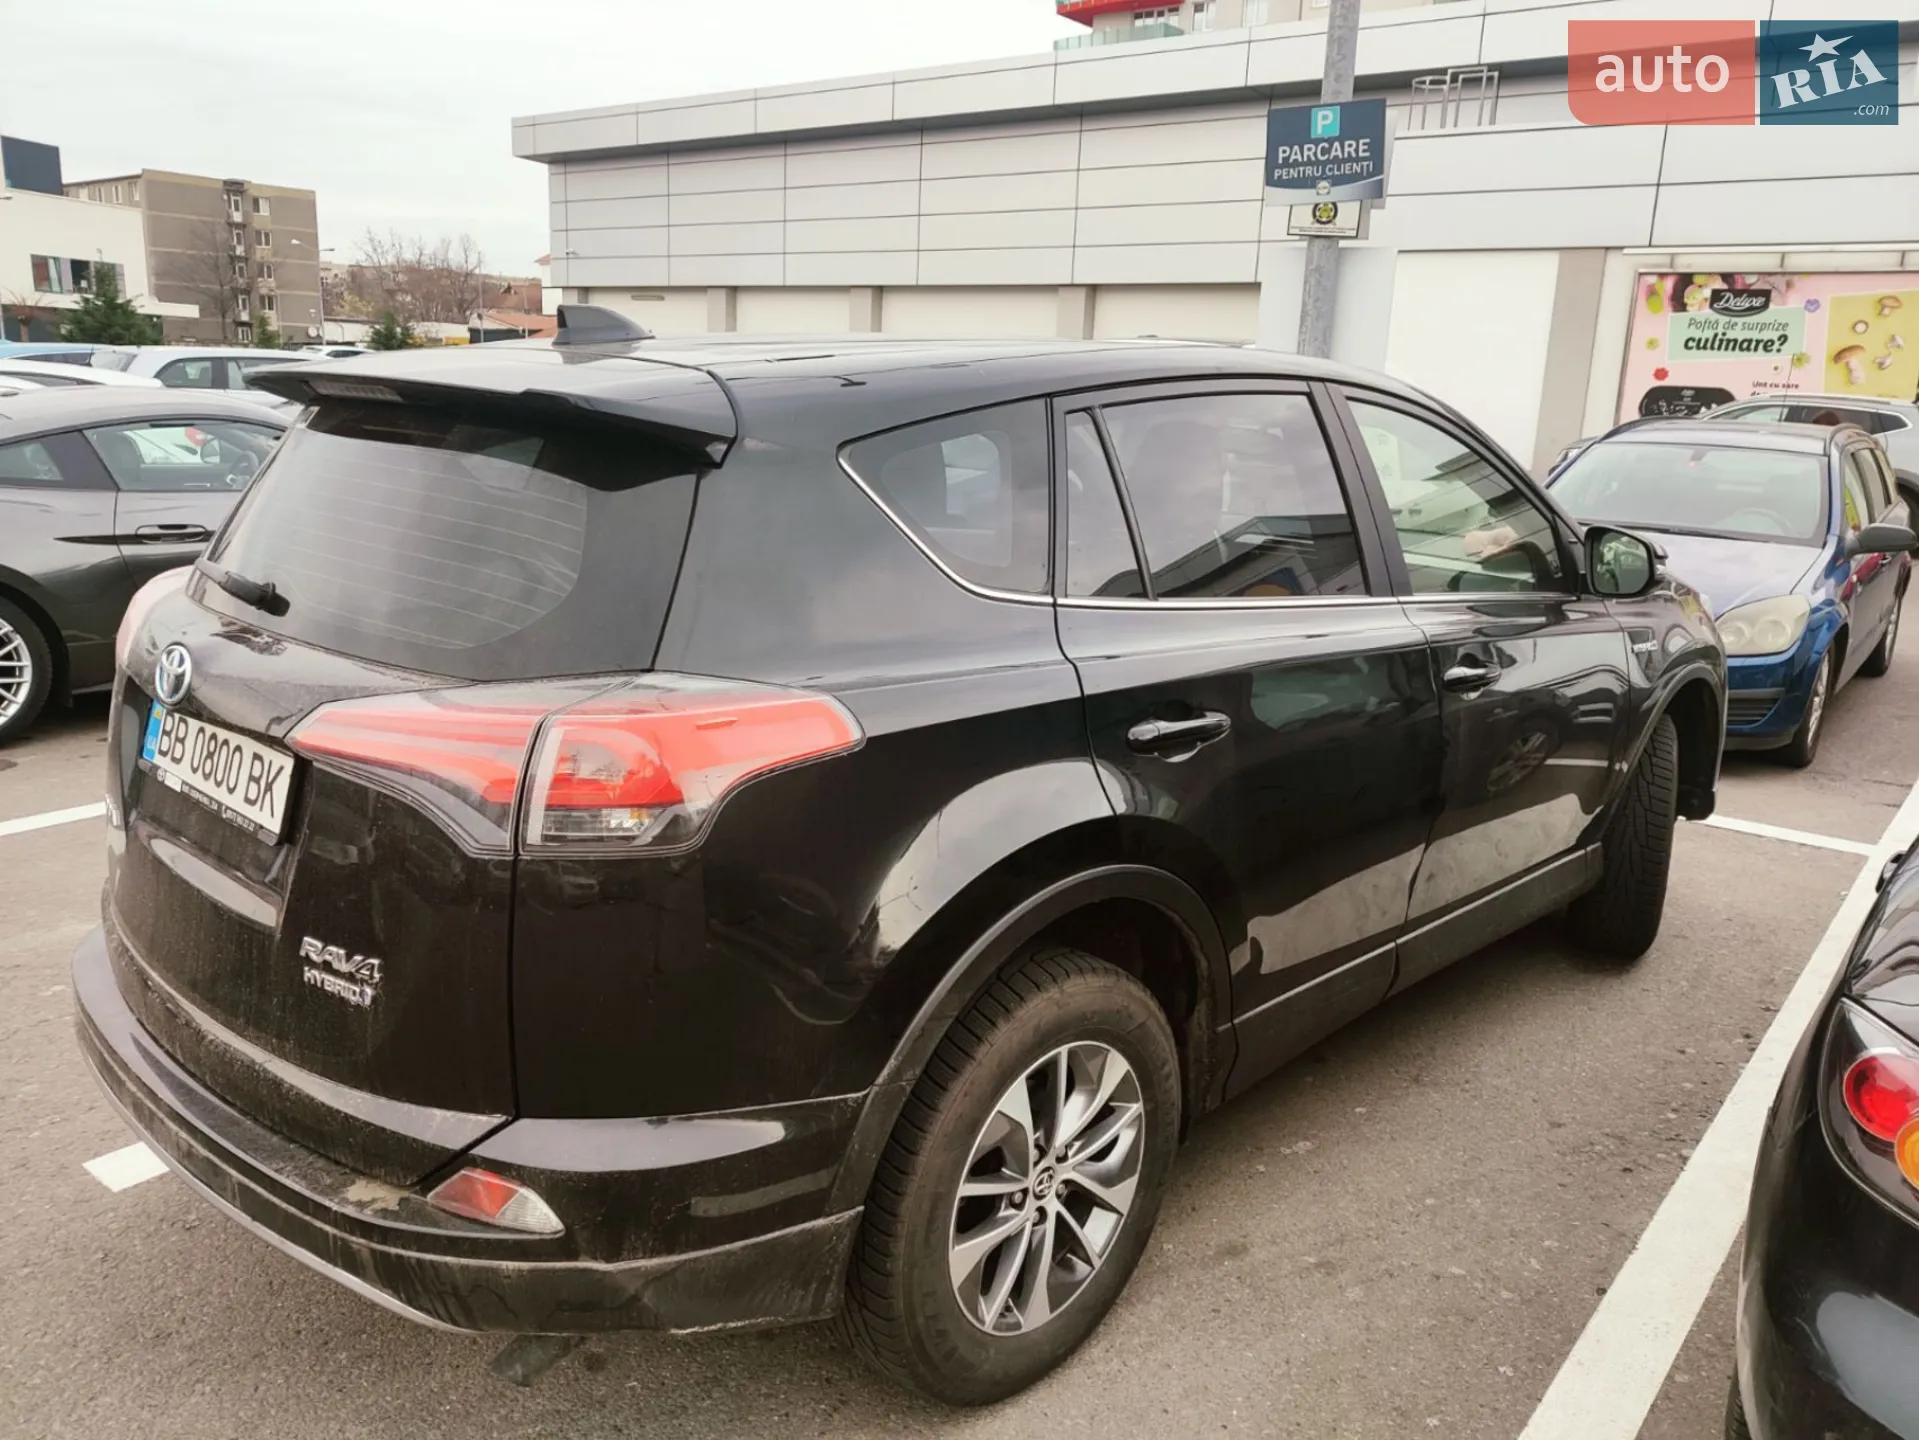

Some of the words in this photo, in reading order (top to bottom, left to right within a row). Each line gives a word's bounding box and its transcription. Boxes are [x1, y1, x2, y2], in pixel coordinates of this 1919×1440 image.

[1277, 138, 1371, 164] PARCARE
[1273, 165, 1322, 180] PENTRU
[1713, 291, 1767, 311] Deluxe
[1722, 318, 1738, 331] de
[1740, 317, 1790, 334] surprize
[1683, 331, 1789, 353] culinare?
[158, 712, 189, 766] BB
[190, 726, 244, 795] 0800
[243, 751, 285, 819] BK
[299, 936, 381, 983] RAV4
